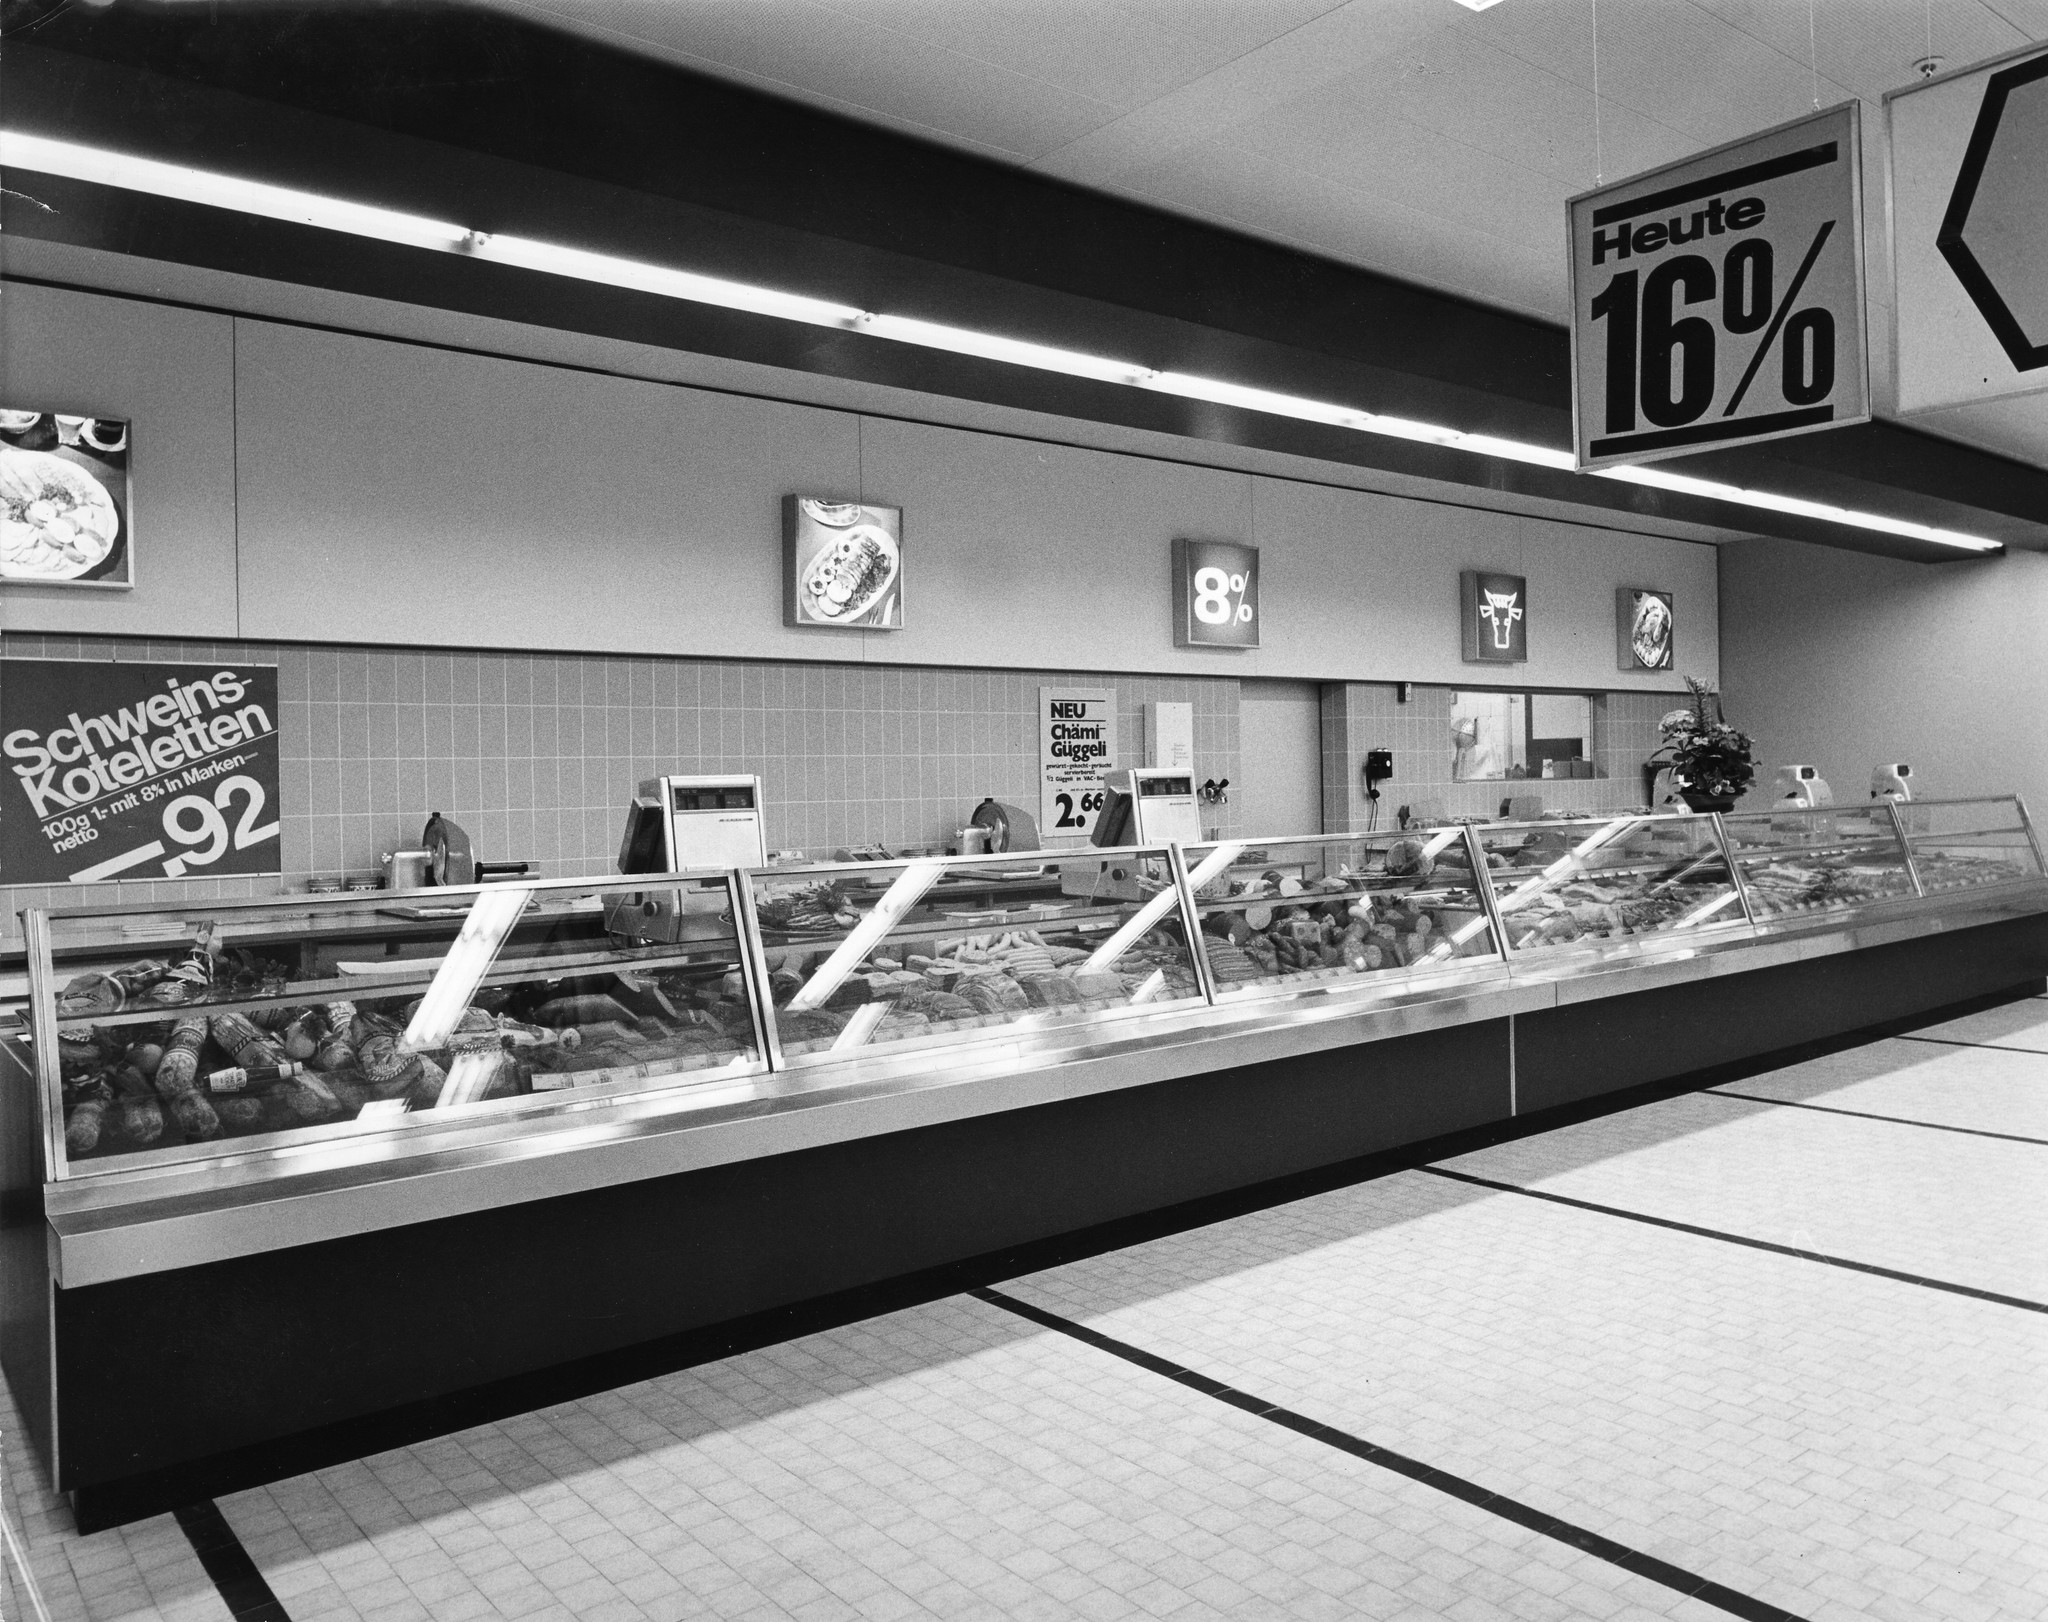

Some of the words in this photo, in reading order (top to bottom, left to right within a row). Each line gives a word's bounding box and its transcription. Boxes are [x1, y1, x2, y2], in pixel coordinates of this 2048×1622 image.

[1592, 197, 1766, 266] Heute
[1591, 220, 1837, 434] 16%
[1194, 567, 1253, 626] 8%
[3, 671, 253, 777] Schweins-
[1050, 702, 1086, 719] NEU
[20, 703, 273, 818] Koteletten
[1050, 740, 1107, 762] Güggeli
[41, 814, 91, 841] 100g
[110, 792, 140, 814] mit
[140, 782, 166, 803] 8%
[164, 778, 183, 793] in
[1055, 792, 1104, 828] 2.66
[52, 828, 99, 854] netto
